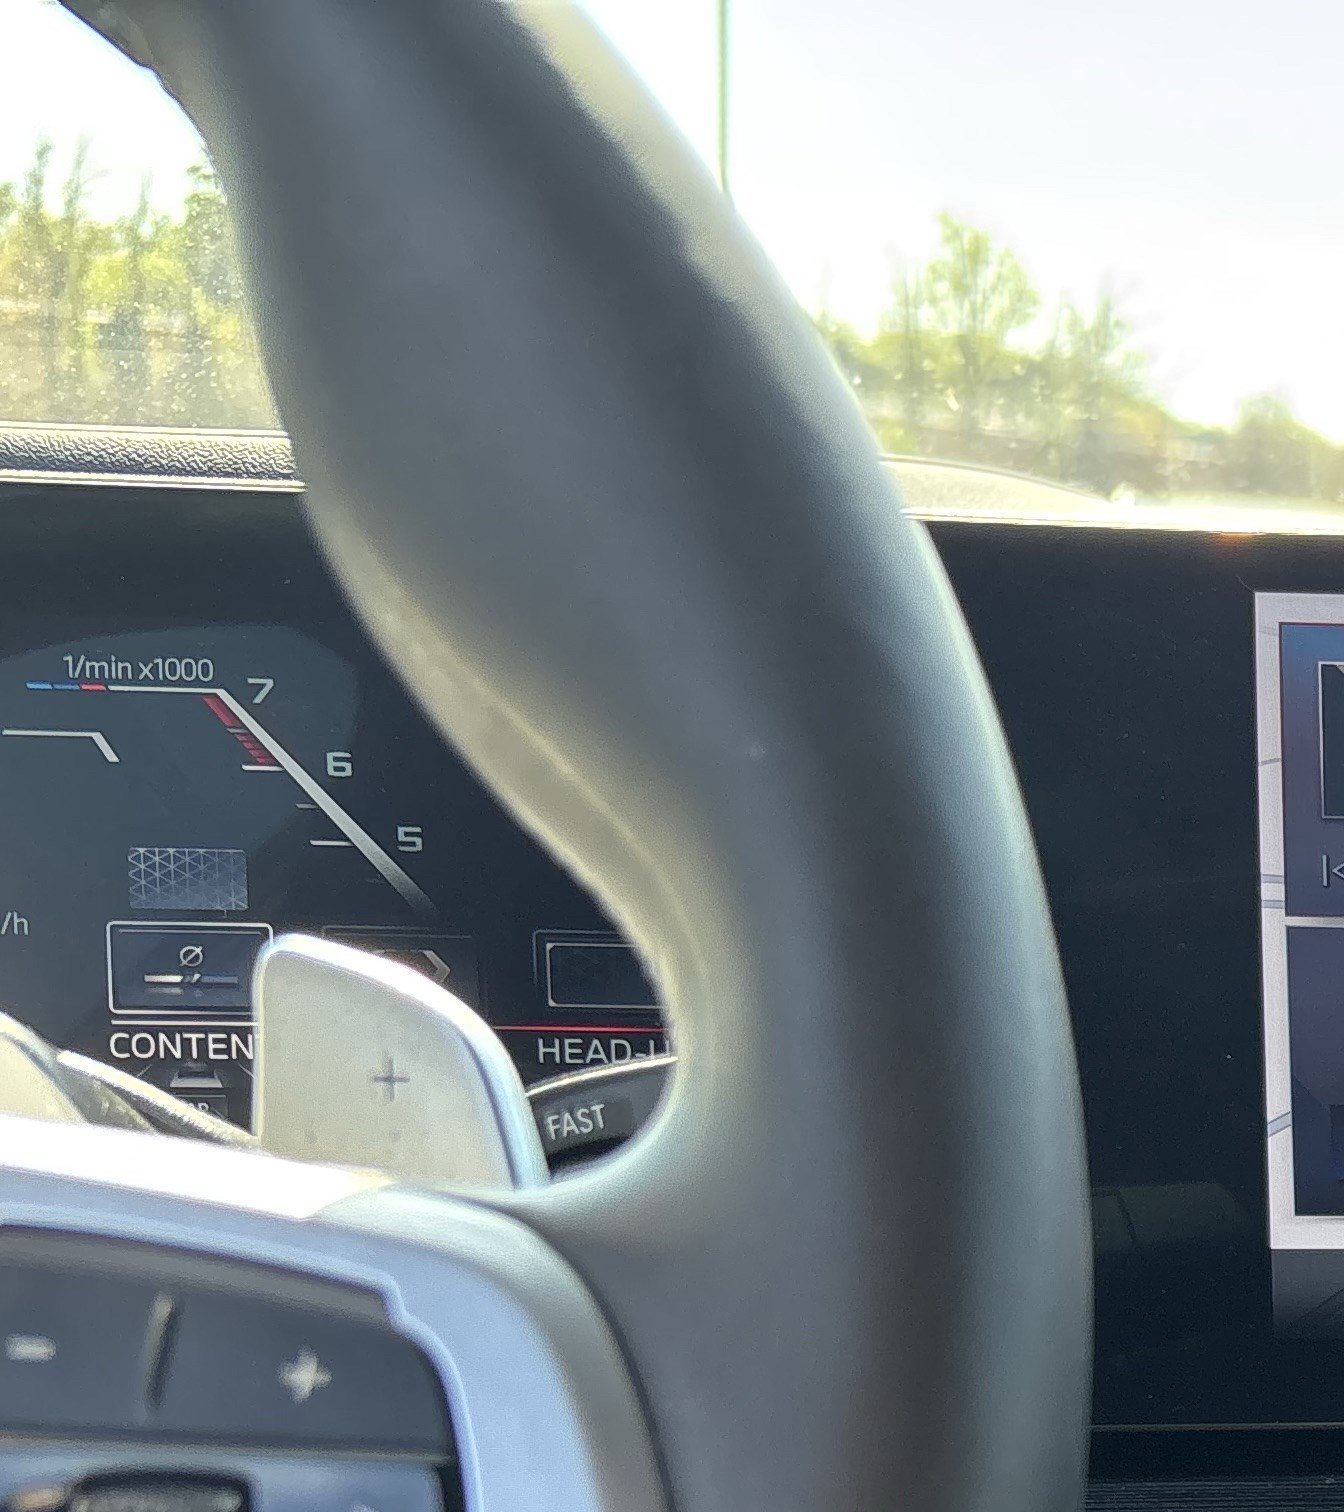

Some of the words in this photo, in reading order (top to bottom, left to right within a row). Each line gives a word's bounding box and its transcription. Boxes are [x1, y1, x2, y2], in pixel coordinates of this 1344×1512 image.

[62, 655, 133, 680] 1/min
[138, 657, 215, 682] x1000
[247, 677, 275, 705] 7
[326, 751, 354, 778] 6
[397, 826, 424, 853] 5
[109, 1032, 258, 1060] CONTEN
[546, 1104, 605, 1141] FAST
